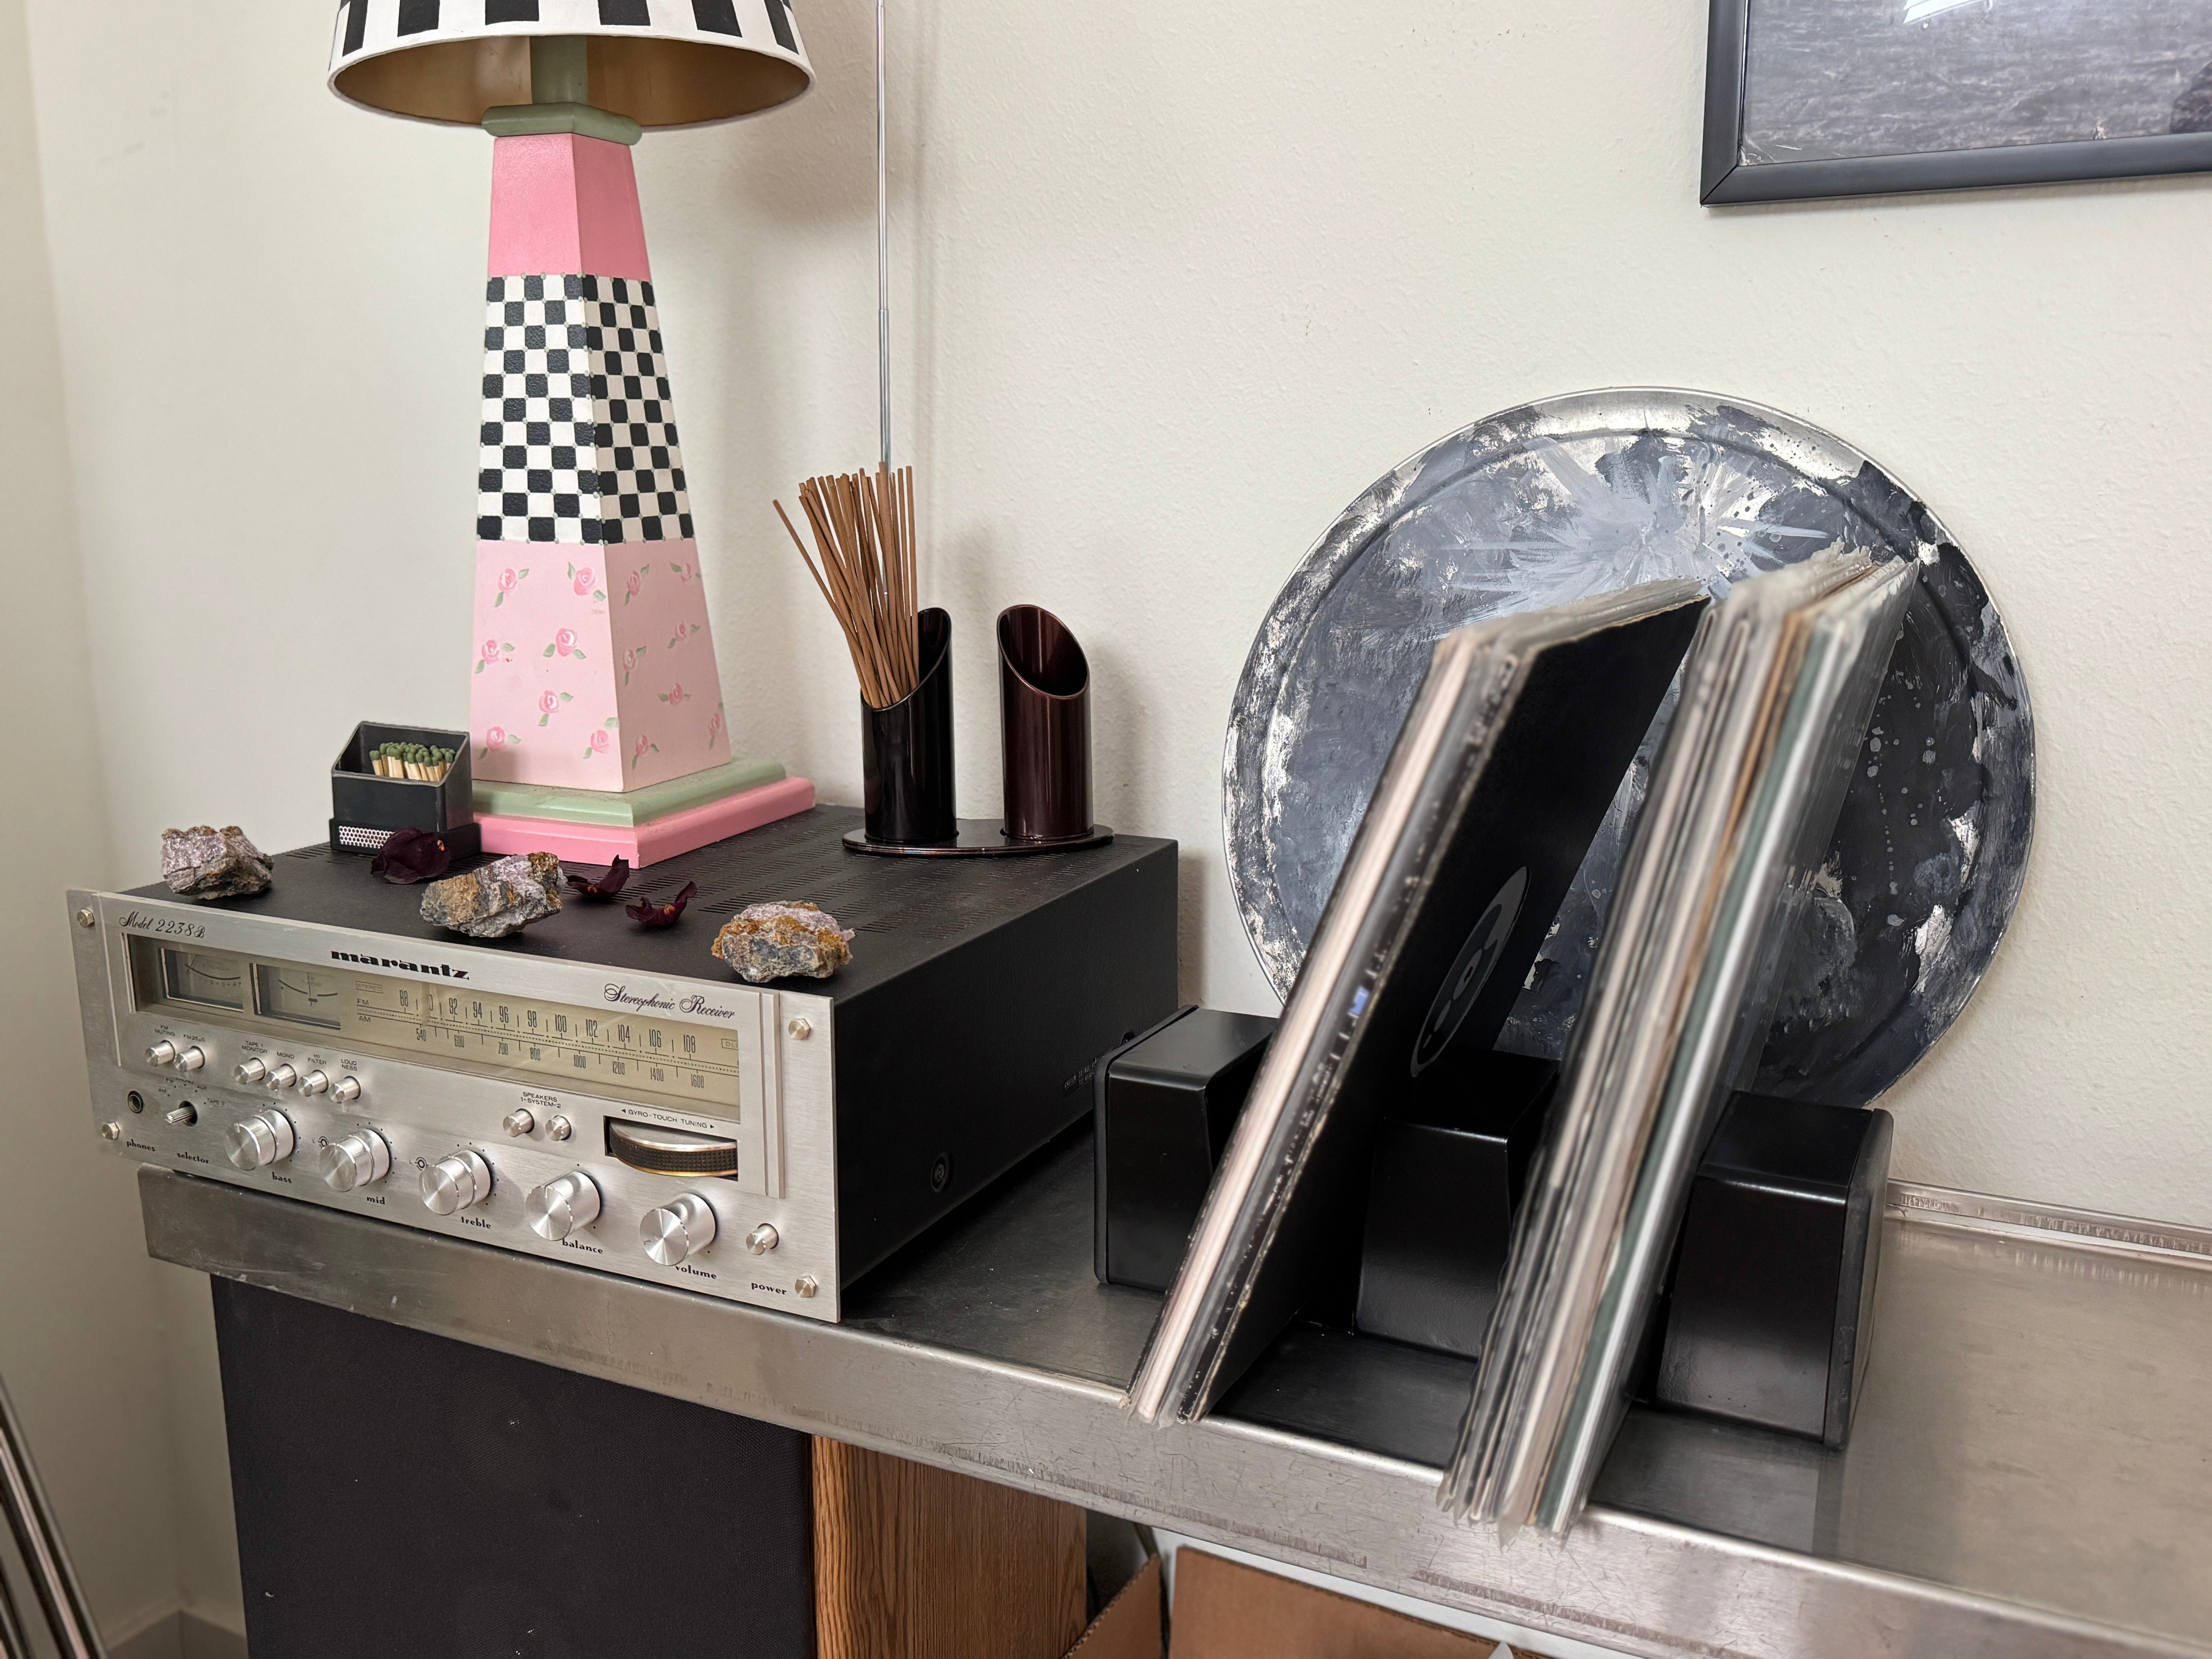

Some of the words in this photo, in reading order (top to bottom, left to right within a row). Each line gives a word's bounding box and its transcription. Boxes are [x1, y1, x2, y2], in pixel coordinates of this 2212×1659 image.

[119, 911, 153, 929] Model
[155, 919, 205, 938] 2238B
[331, 951, 469, 980] marantz
[604, 983, 675, 1012] Stereophonic
[680, 995, 735, 1019] Receiver
[400, 990, 409, 1007] 88
[449, 998, 458, 1015] 92
[473, 1001, 482, 1019] 94
[500, 1006, 509, 1023] 96
[527, 1010, 537, 1027] 98
[555, 1014, 567, 1032] 100
[586, 1019, 598, 1037] 102
[618, 1024, 630, 1042] 104
[649, 1029, 661, 1048] 106
[684, 1034, 696, 1053] 108
[242, 1045, 268, 1054] MONITOR
[416, 1028, 426, 1041] 540
[454, 1035, 464, 1047] 600
[498, 1042, 508, 1055] 700
[530, 1048, 541, 1061] 800
[574, 1054, 586, 1068] 1000
[613, 1061, 625, 1075] 1200
[651, 1067, 664, 1082] 1400
[691, 1074, 704, 1088] 1600
[523, 1092, 558, 1102] SPEAKERS
[681, 1118, 707, 1128] TUNING
[126, 1139, 155, 1152] phones
[177, 1152, 210, 1164] selector
[272, 1171, 292, 1183] bass
[367, 1196, 385, 1205] mid
[461, 1216, 491, 1229] treble
[562, 1239, 603, 1254] balance
[675, 1264, 717, 1279] volume
[751, 1282, 787, 1295] power
